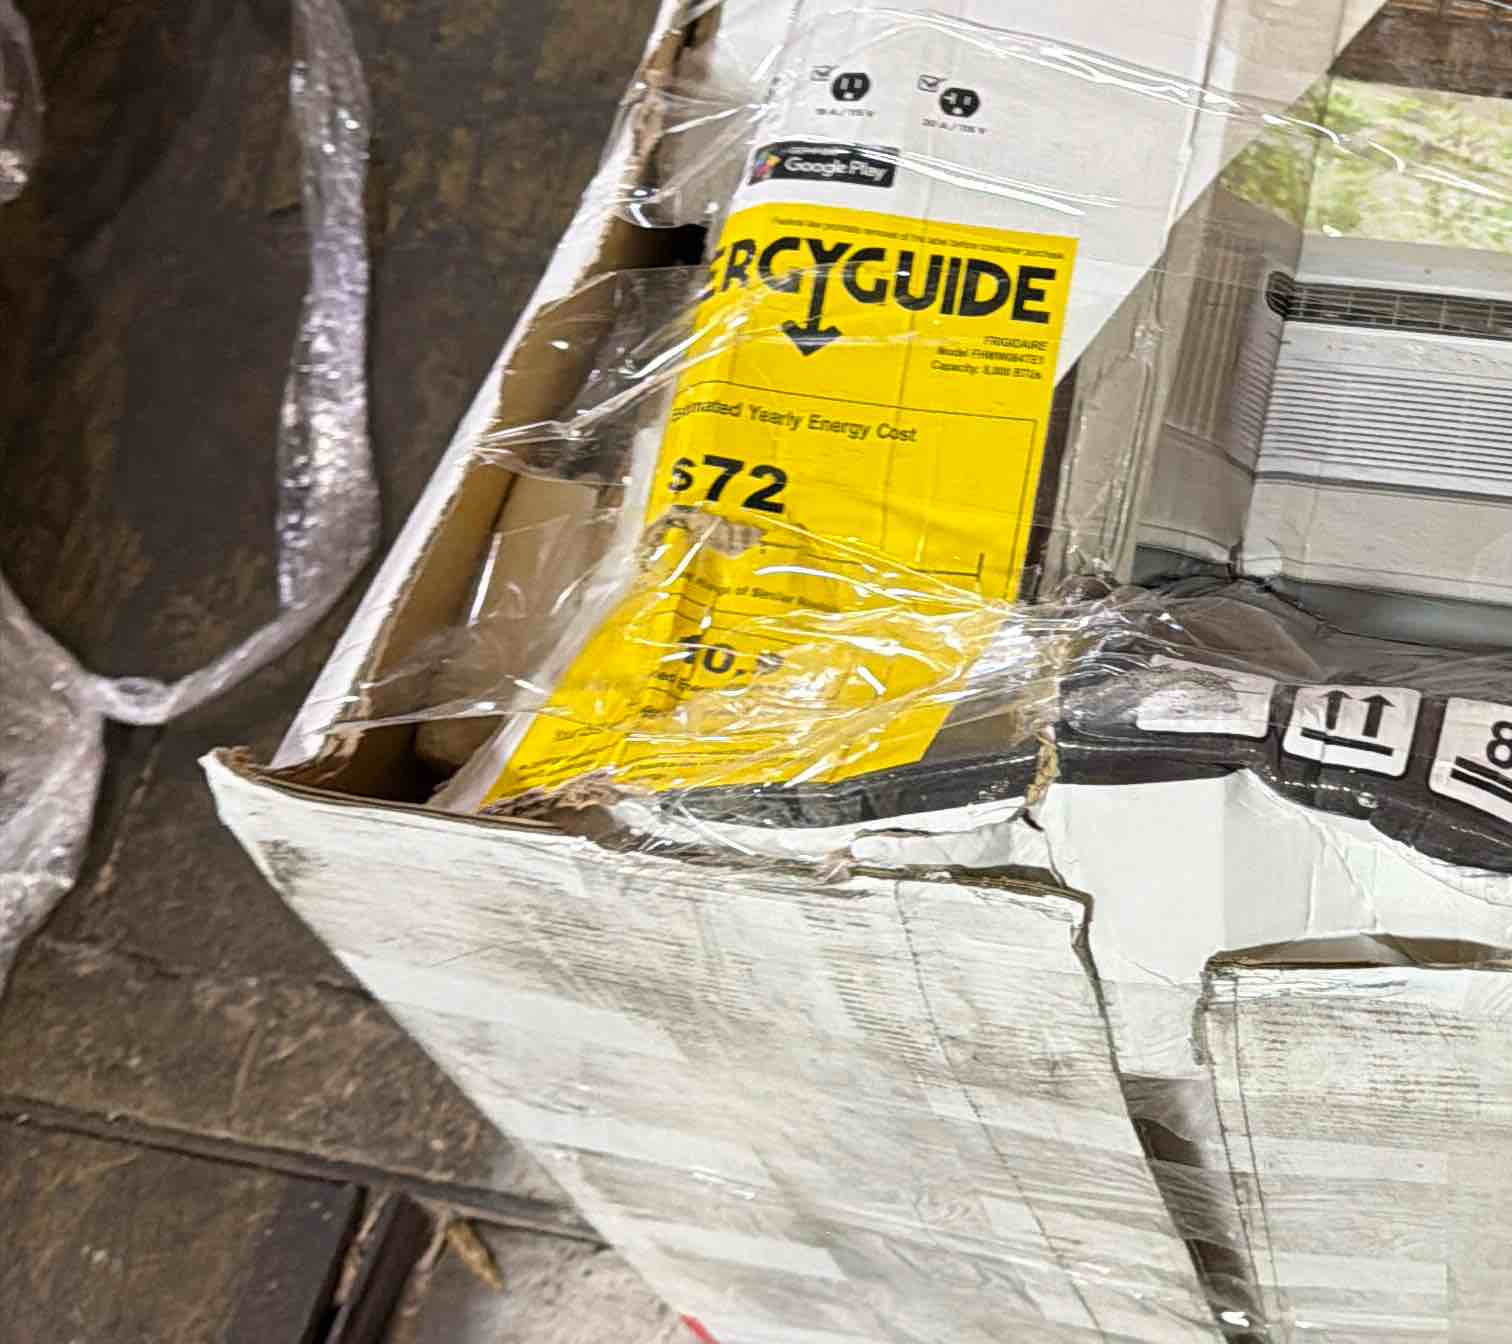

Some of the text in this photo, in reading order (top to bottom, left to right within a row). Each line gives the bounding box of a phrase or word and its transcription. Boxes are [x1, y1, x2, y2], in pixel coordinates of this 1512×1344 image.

[784, 156, 889, 182] Google Play
[749, 405, 802, 431] Yearly
[807, 414, 871, 441] Energy
[876, 422, 919, 443] Cost
[667, 454, 789, 514] $72
